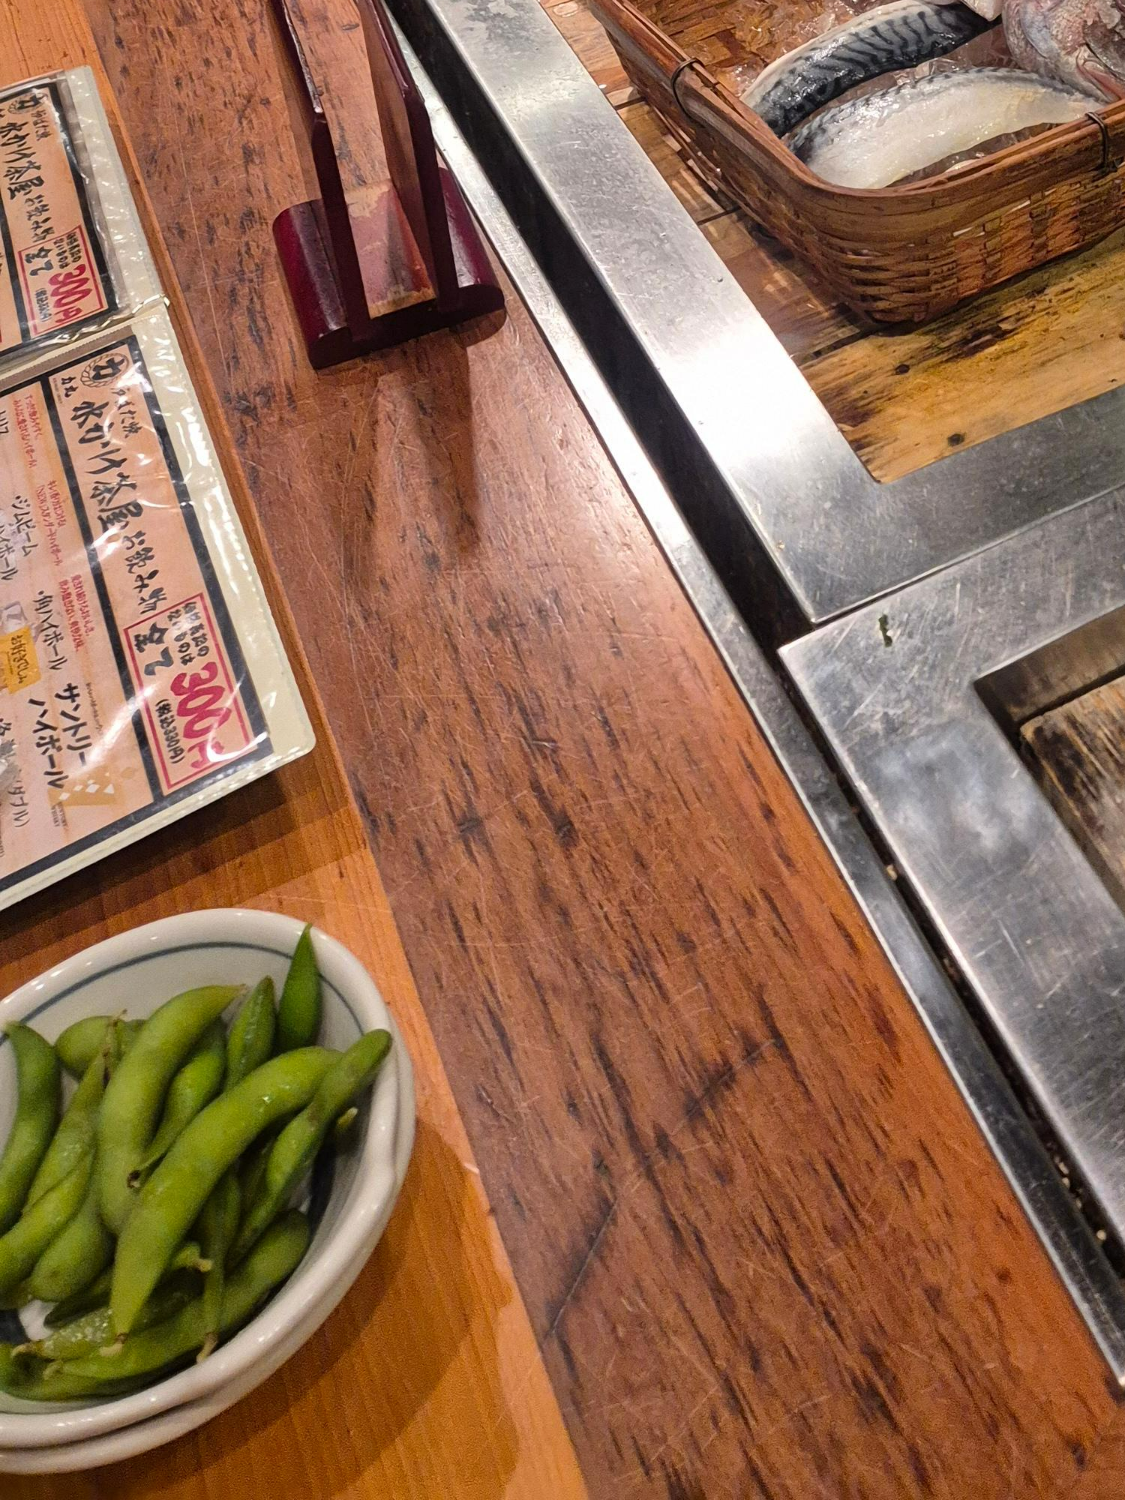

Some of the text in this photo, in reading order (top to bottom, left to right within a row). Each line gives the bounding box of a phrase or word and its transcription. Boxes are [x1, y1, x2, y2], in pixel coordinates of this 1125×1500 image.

[48, 264, 93, 324] 300円
[71, 400, 168, 615] 水かけ茶屋 お飲み物
[133, 622, 174, 676] 全て
[28, 699, 69, 789] ハイボール
[55, 683, 92, 767] サントリー
[154, 698, 185, 765] (税込330円)
[170, 662, 232, 770] 300円
